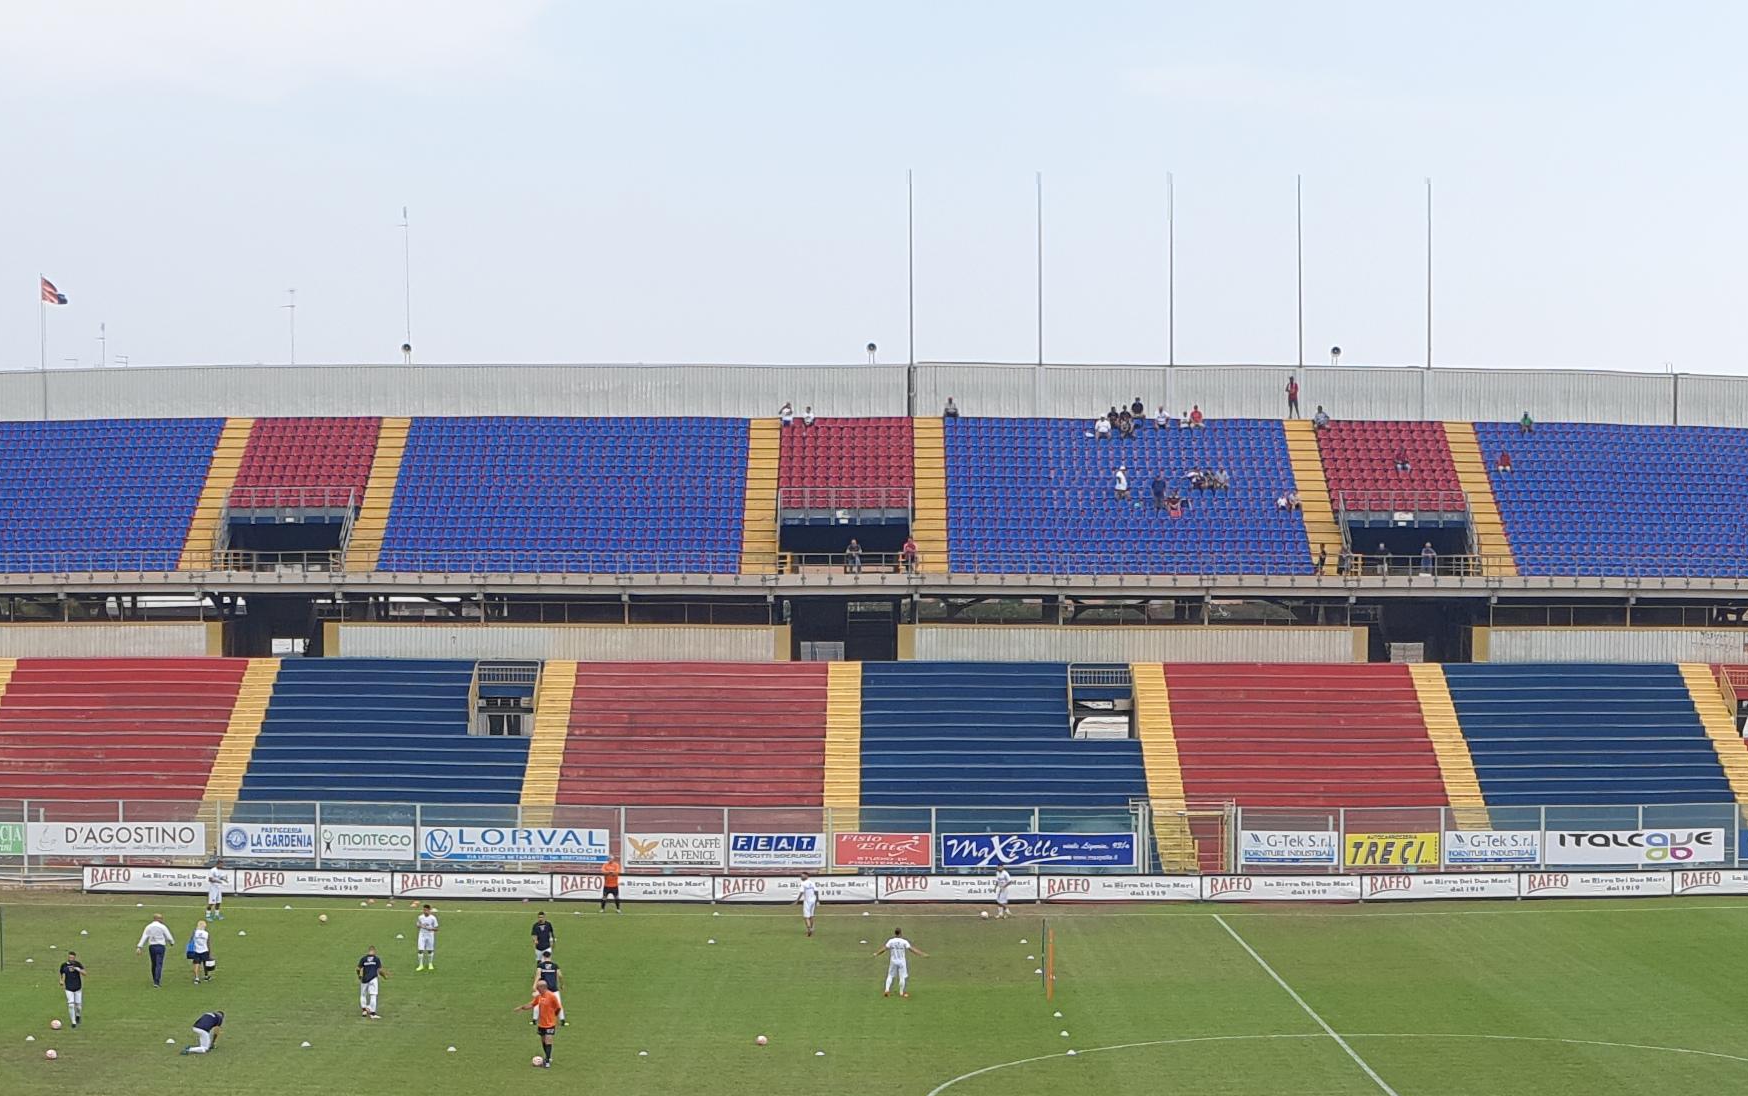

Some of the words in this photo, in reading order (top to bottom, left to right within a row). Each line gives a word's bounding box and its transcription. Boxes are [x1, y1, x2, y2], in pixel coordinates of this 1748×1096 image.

[65, 826, 195, 844] D'AGOSTINO
[251, 835, 263, 848] LA
[265, 834, 313, 849] GARDENIA
[459, 829, 606, 846] LORVAL
[661, 838, 692, 849] GRAN
[693, 836, 721, 849] CAFFÈ
[1266, 834, 1304, 848] G-Tek
[1308, 834, 1335, 848] S.r.l.
[1470, 834, 1508, 848] G-Tek
[1512, 834, 1538, 848] S.r.l.
[666, 850, 680, 859] LA
[682, 850, 716, 860] FENICE
[91, 868, 132, 883] RAFFO
[244, 872, 285, 886] RAFFO
[401, 874, 443, 888] RAFFO
[560, 875, 603, 889] RAFFO
[1370, 875, 1411, 891] RAFFO
[1528, 873, 1569, 889] RAFFO
[1681, 871, 1721, 887] RAFFO
[723, 879, 766, 893] RAFFO
[885, 876, 928, 891] RAFFO
[1047, 878, 1090, 893] RAFFO
[1210, 877, 1252, 892] RAFFO
